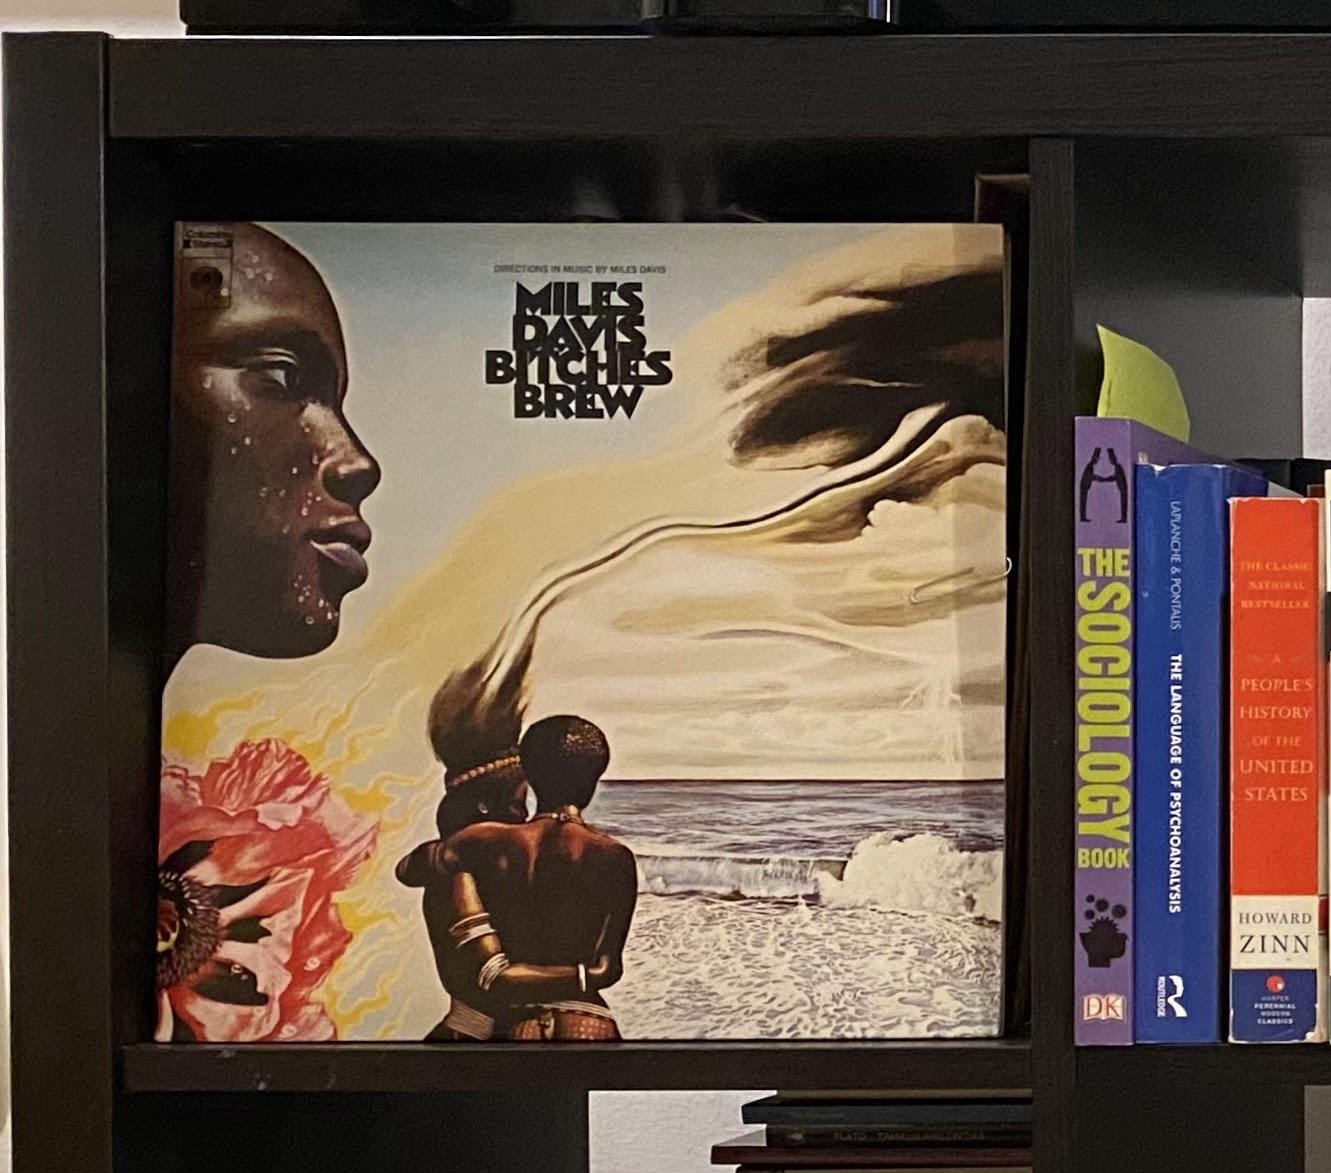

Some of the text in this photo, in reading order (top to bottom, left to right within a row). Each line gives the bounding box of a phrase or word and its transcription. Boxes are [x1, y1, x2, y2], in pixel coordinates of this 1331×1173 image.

[494, 265, 666, 273] DIRECTIONS IN MUSIC BY MILES DAVIS
[516, 281, 644, 316] MILES
[512, 314, 647, 352] DAVIS
[485, 351, 672, 385] BITCHES
[514, 386, 645, 419] BREW
[1077, 548, 1131, 577] THE
[1077, 581, 1132, 844] SOCIOLOGY
[1169, 654, 1182, 913] THE LANGUAGE OF PSYCHOANALYSIS
[1078, 848, 1130, 868] BOOK
[1239, 913, 1312, 925] HOWARD
[1240, 935, 1310, 954] ZINN
